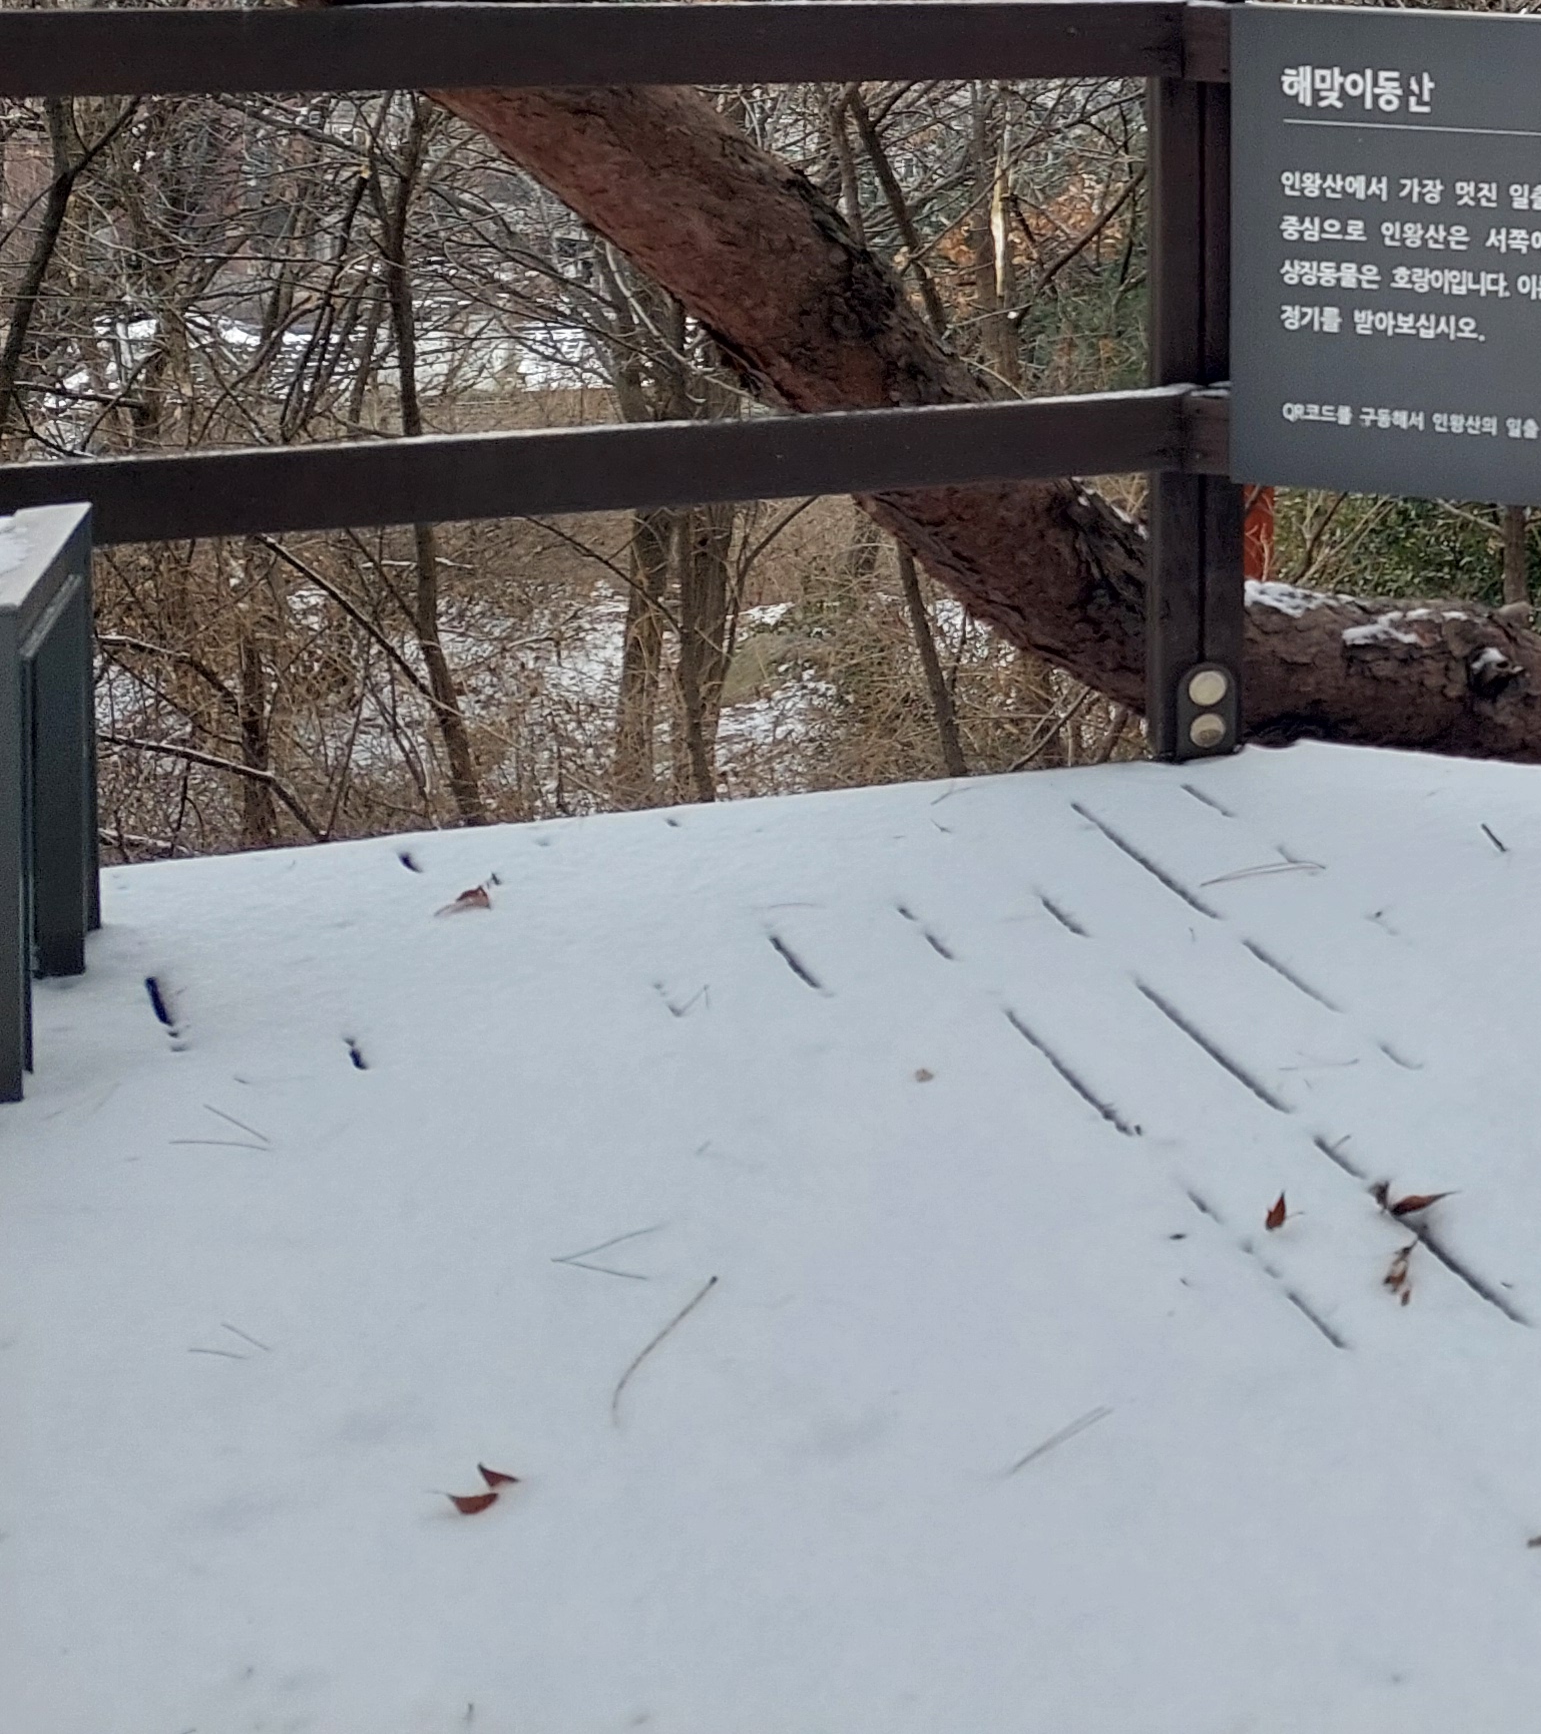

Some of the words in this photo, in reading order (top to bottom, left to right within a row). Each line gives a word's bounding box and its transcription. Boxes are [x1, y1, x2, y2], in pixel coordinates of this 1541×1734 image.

[1280, 65, 1435, 113] 해맞이동산
[1280, 170, 1388, 202] 인왕산에서
[1398, 177, 1444, 205] 가장
[1455, 181, 1498, 207] 멋진
[1279, 214, 1368, 242] 중심으로
[1380, 221, 1471, 250] 인왕산은
[1279, 258, 1382, 290] 상징동물은
[1389, 266, 1512, 298] 호랑이입니다.
[1279, 304, 1343, 333] 정기를
[1353, 309, 1486, 342] 받아보십시오.
[1282, 401, 1353, 426] QR코드를
[1432, 412, 1498, 436] 인왕산의
[1506, 417, 1539, 439] 일출
